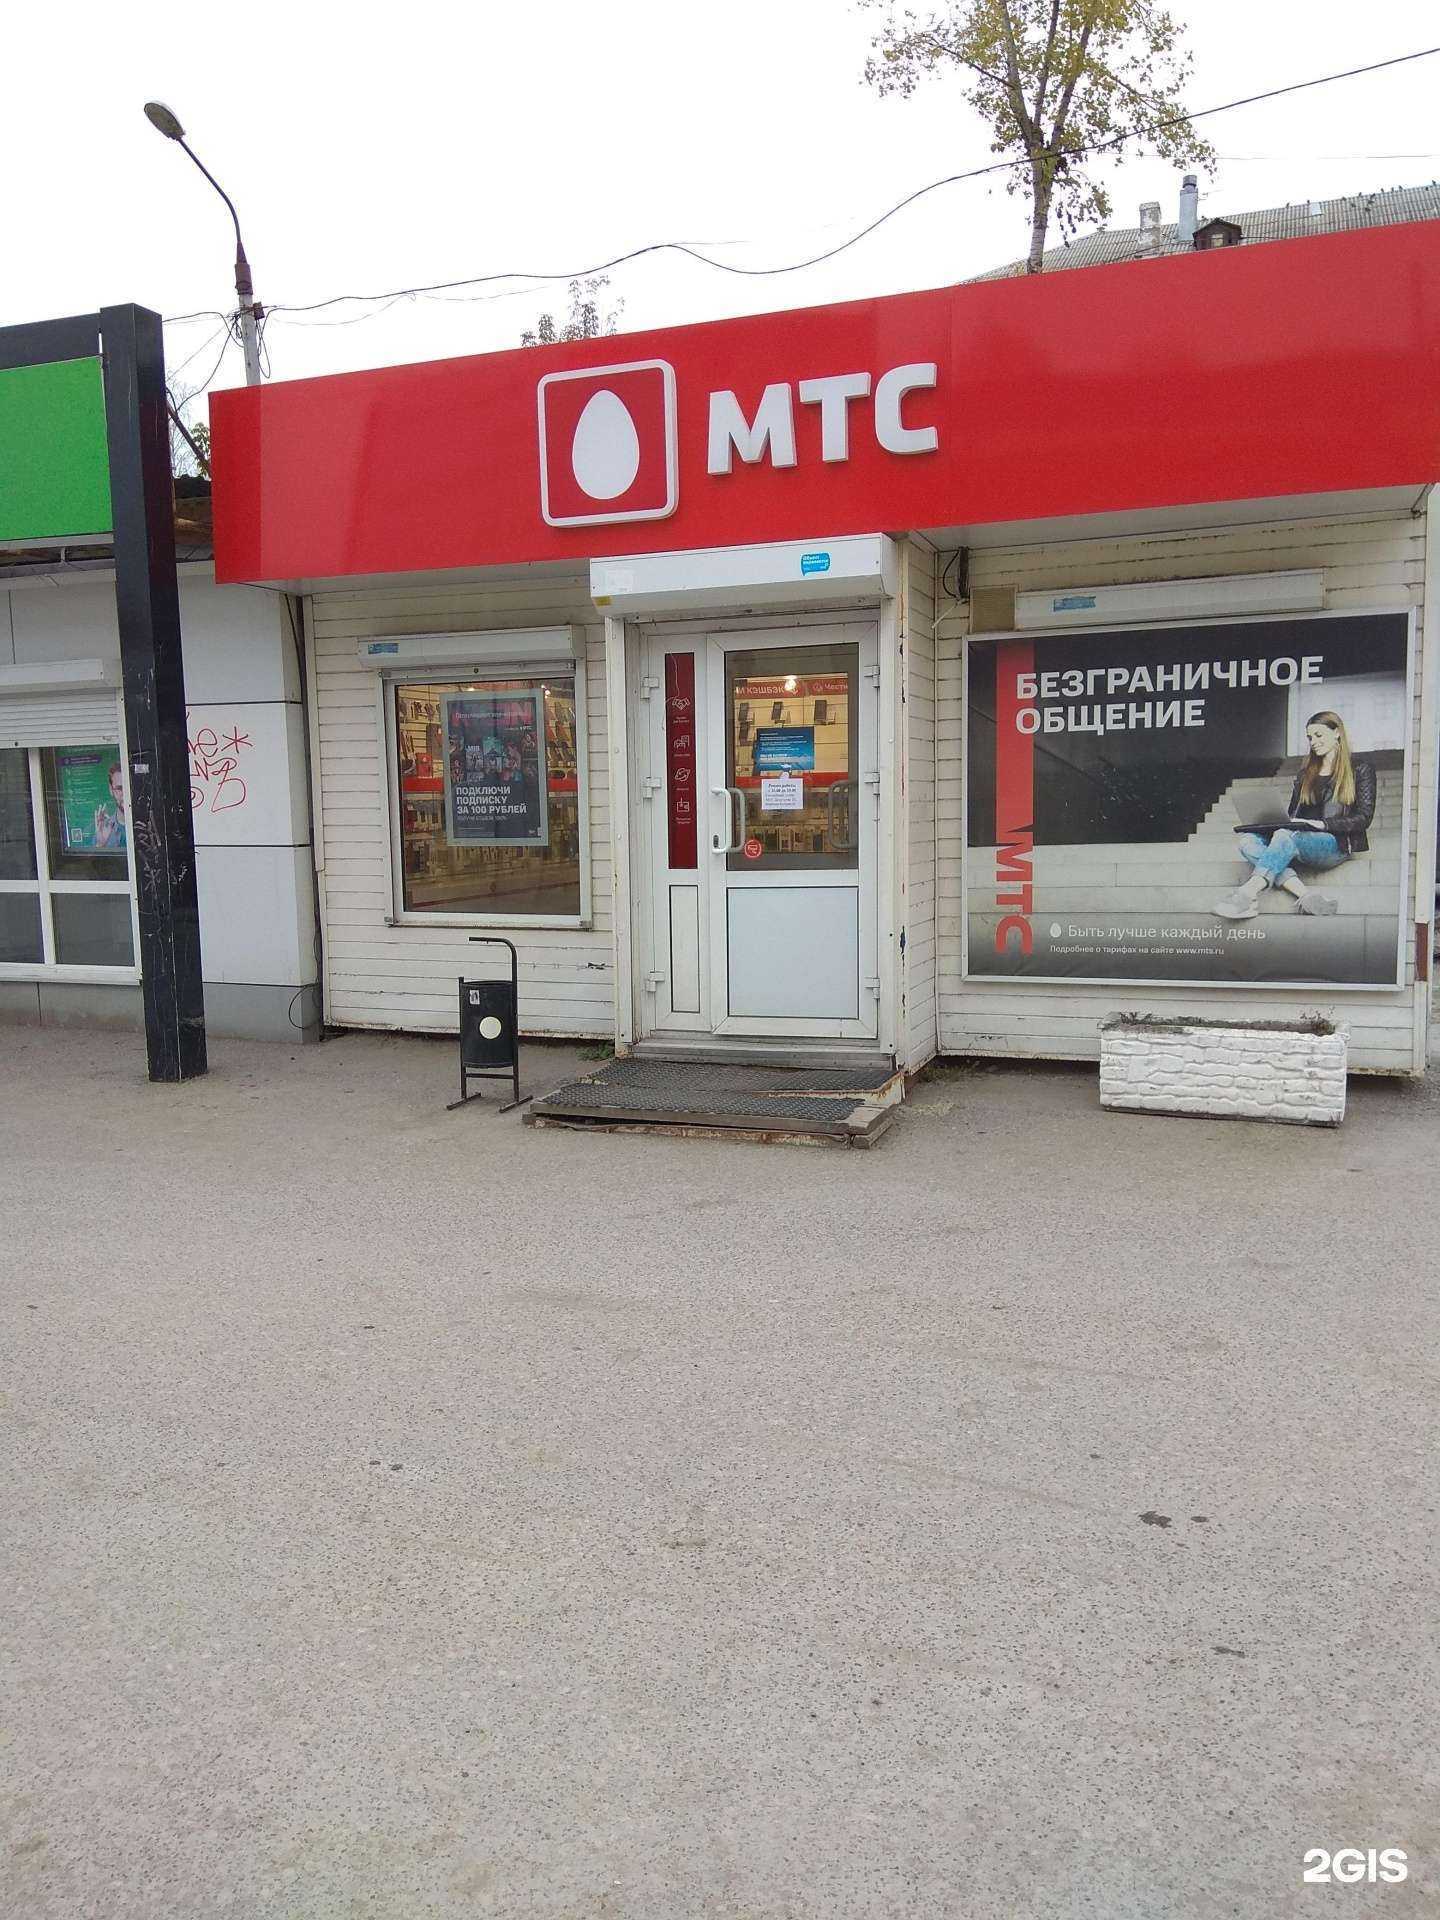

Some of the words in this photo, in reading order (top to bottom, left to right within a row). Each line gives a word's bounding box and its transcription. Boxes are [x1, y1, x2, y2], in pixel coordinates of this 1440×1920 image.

[707, 362, 939, 475] МТС
[1016, 655, 1325, 699] БЕЗГРАНИЧНОЕ
[1015, 699, 1206, 736] ОБЩЕНИЕ
[456, 786, 511, 797] ПОДКЛЮЧИ
[456, 796, 508, 805] ПОДПИСКУ
[457, 805, 469, 814] ЗА
[471, 805, 487, 814] 100
[488, 803, 527, 814] РУБЛЕЙ
[996, 831, 1033, 956] МТС
[1068, 924, 1104, 937] Быть
[1108, 926, 1157, 940] лучше
[1160, 924, 1223, 940] каждый
[1226, 926, 1266, 941] день
[1050, 945, 1094, 954] Подробнее
[1102, 946, 1137, 954] тарифах
[1150, 946, 1174, 954] сайте
[1176, 946, 1225, 955] www.mts.ru
